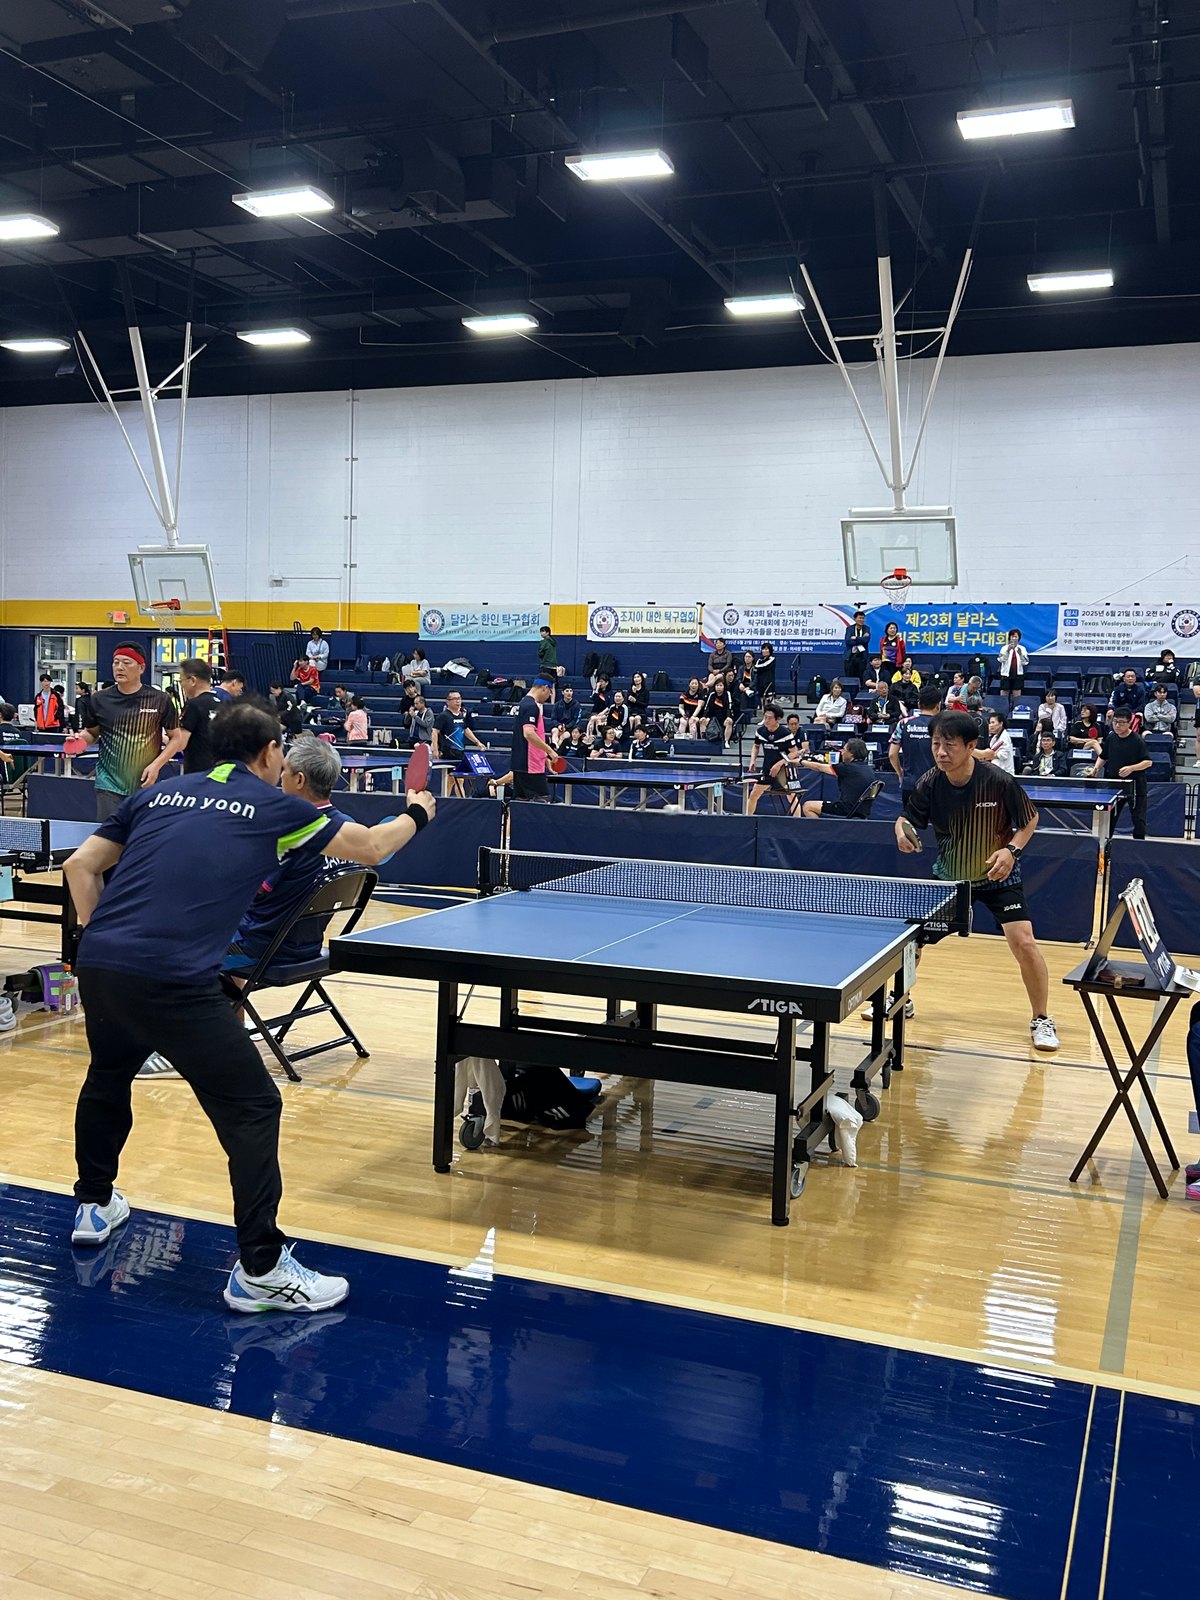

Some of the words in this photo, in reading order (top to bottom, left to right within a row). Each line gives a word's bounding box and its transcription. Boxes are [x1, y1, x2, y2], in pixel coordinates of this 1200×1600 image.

[450, 613, 479, 627] 달라스
[481, 613, 499, 627] 한인
[502, 613, 540, 627] 탁구협회
[620, 610, 643, 622] 조지아
[646, 610, 661, 622] 대한
[664, 611, 695, 623] 탁구협회
[905, 612, 952, 627] 제23회
[957, 612, 999, 627] 달라스
[1101, 620, 1131, 628] Wesleyan
[953, 631, 1009, 646] 탁구대회
[148, 791, 197, 809] John
[200, 797, 256, 819] yoon
[747, 998, 803, 1016] STIGA
